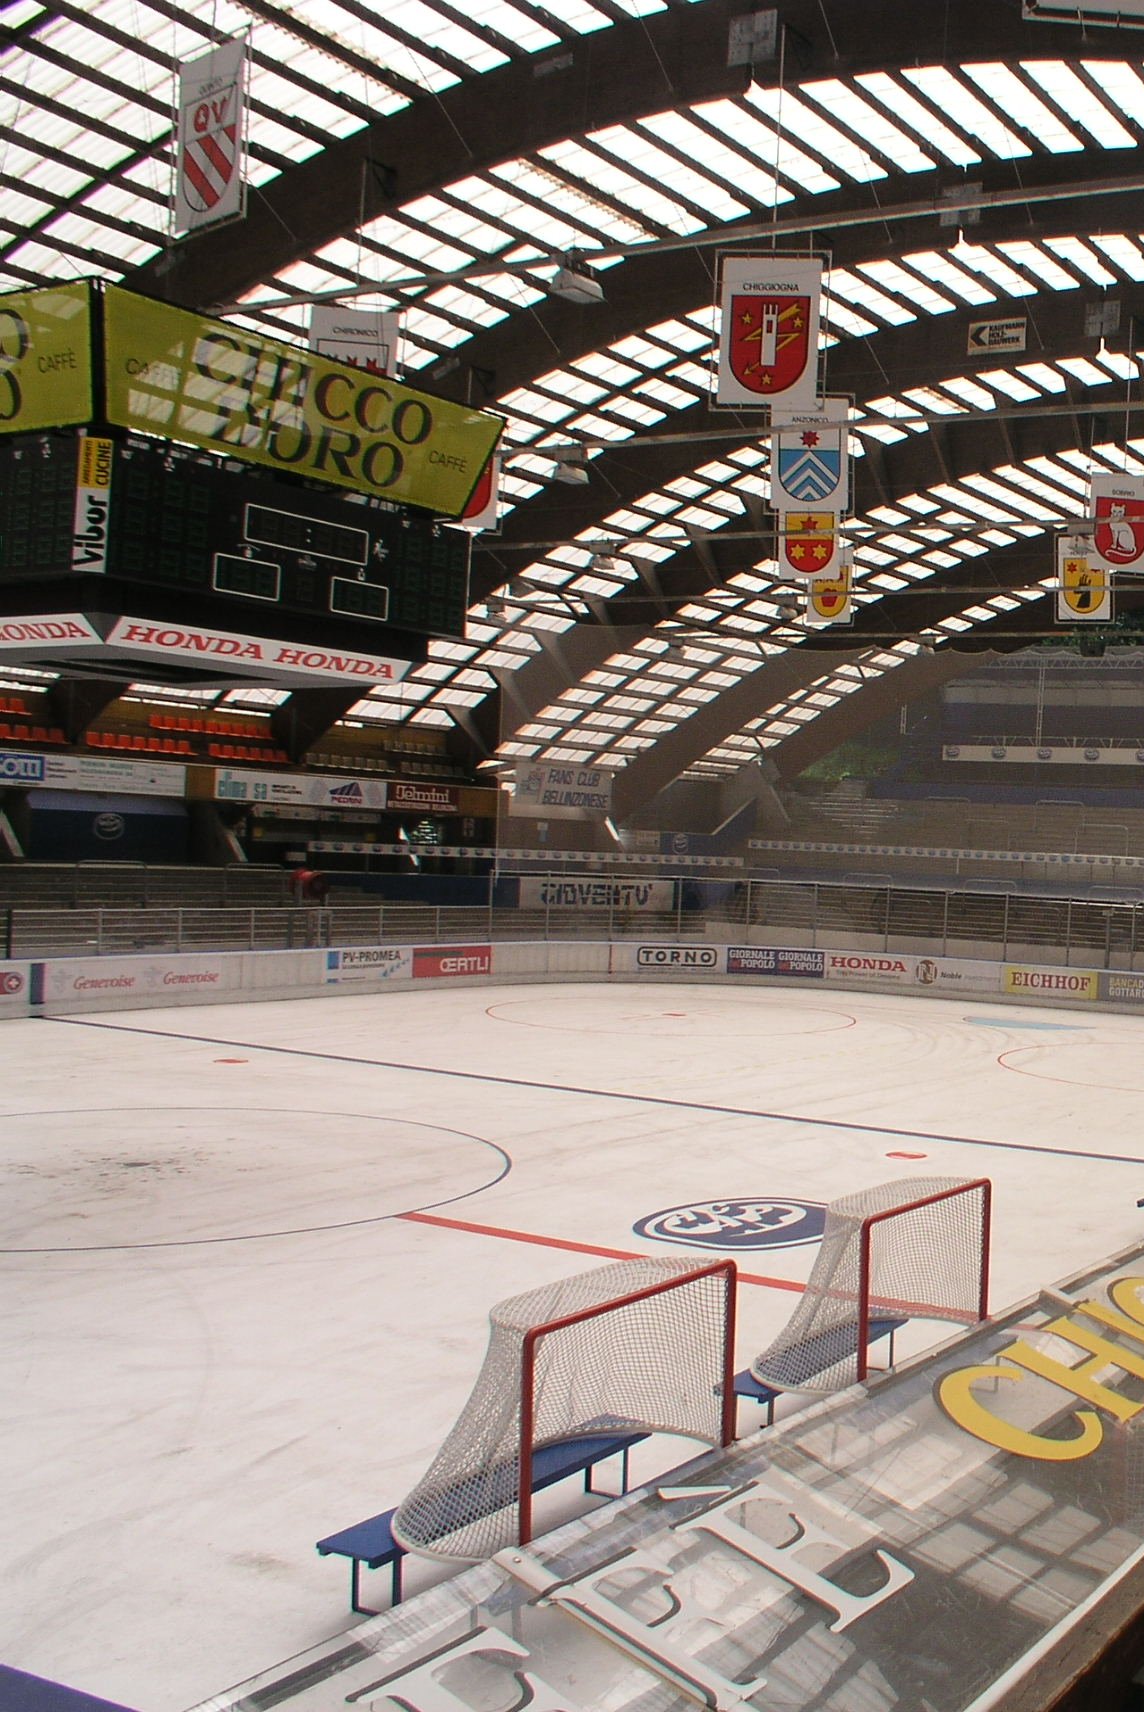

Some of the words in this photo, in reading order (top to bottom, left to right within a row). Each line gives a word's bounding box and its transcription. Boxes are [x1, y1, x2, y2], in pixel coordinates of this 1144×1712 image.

[743, 282, 799, 292] CHIGGIOGNA
[332, 326, 379, 337] CHIRONICO
[37, 347, 78, 374] CAFFÈ
[96, 441, 111, 487] CUCINE
[427, 449, 469, 475] CAFFÈ
[120, 624, 264, 661] HONDA
[273, 647, 394, 680] HONDA
[548, 769, 573, 785] FANS
[577, 770, 600, 787] CLUB
[342, 950, 401, 963] PV-PROMEA
[642, 950, 713, 964] TORNO
[729, 949, 775, 960] GIORNALE
[778, 951, 823, 962] GIORNALE
[740, 958, 775, 969] POPOLO
[790, 961, 823, 972] POPOLO
[830, 956, 907, 973] HONDA
[1011, 971, 1091, 991] EICHHOF
